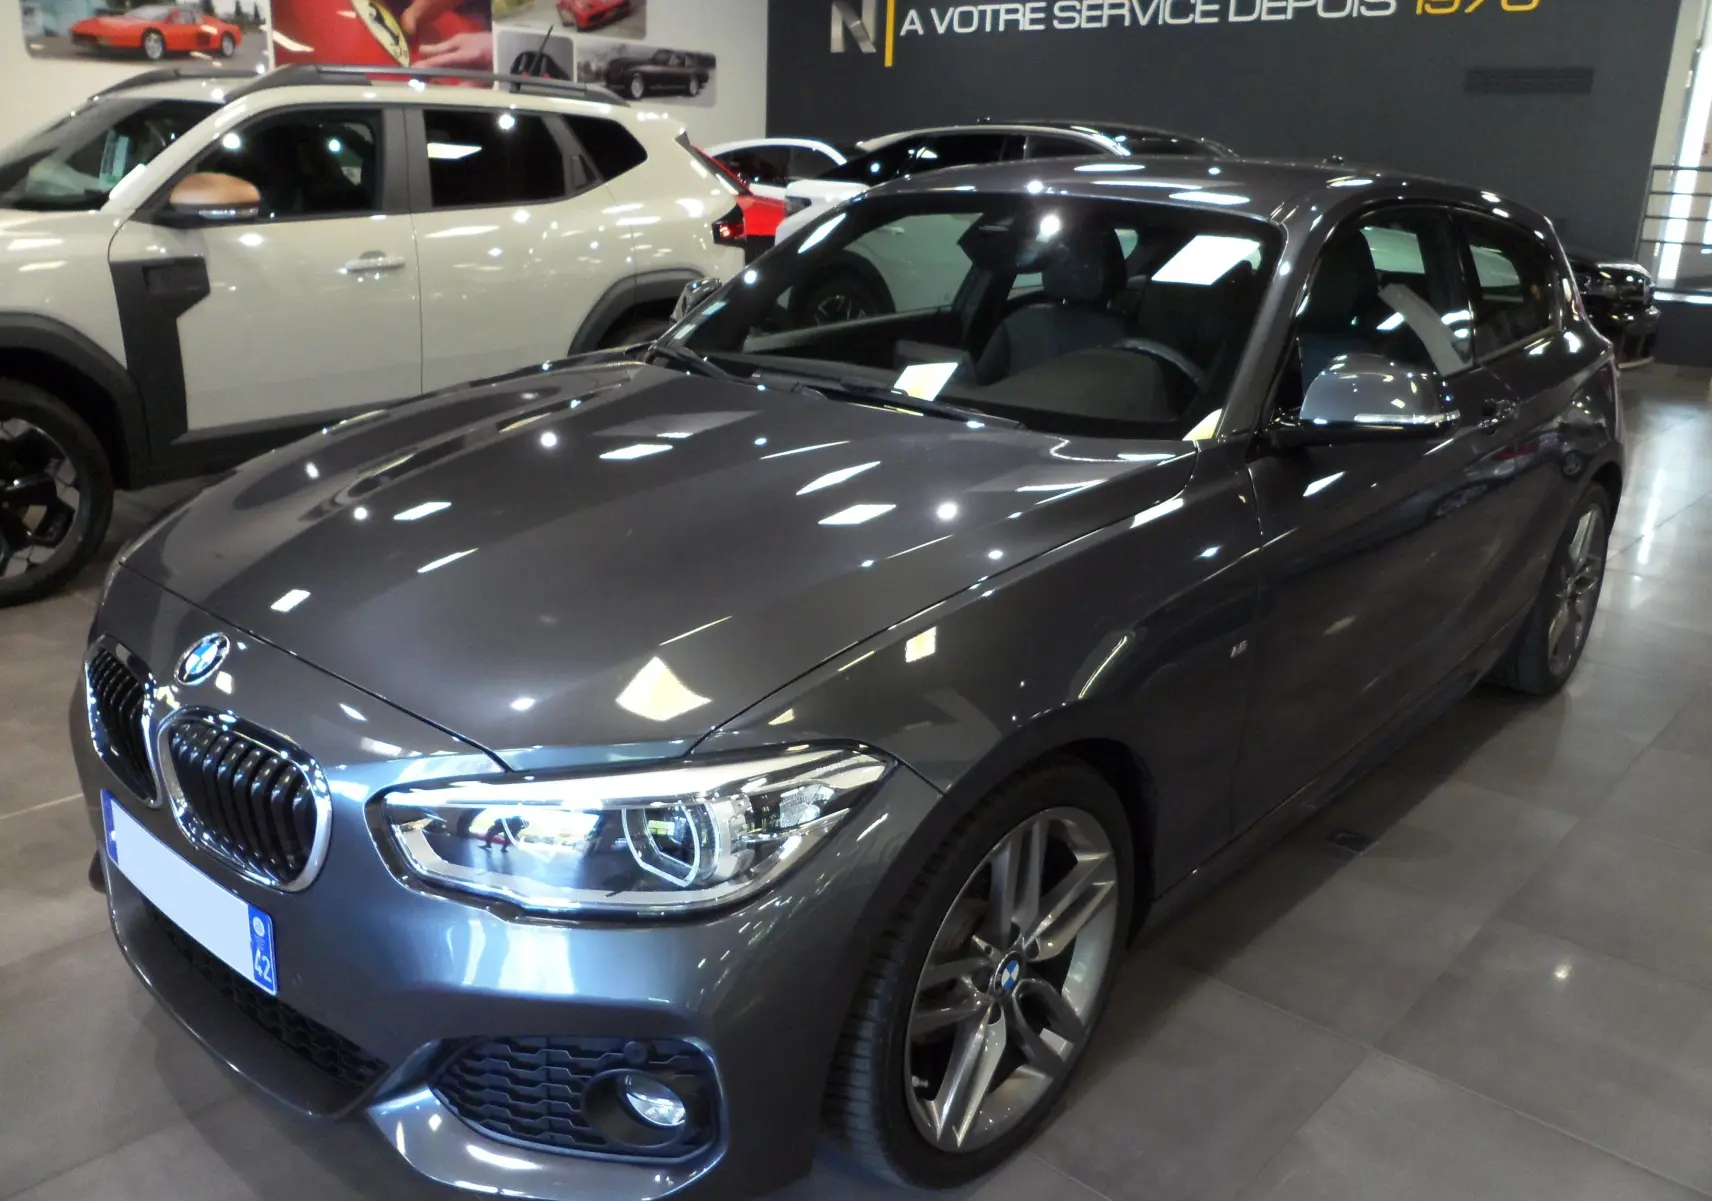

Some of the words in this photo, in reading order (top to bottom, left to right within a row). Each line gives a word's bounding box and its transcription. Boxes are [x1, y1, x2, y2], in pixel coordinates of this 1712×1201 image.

[899, 9, 924, 36] A
[930, 2, 1047, 35] VOTRE
[1052, 0, 1220, 29] SERVICE
[1228, 0, 1397, 23] DEPUIS
[254, 947, 273, 983] 42
